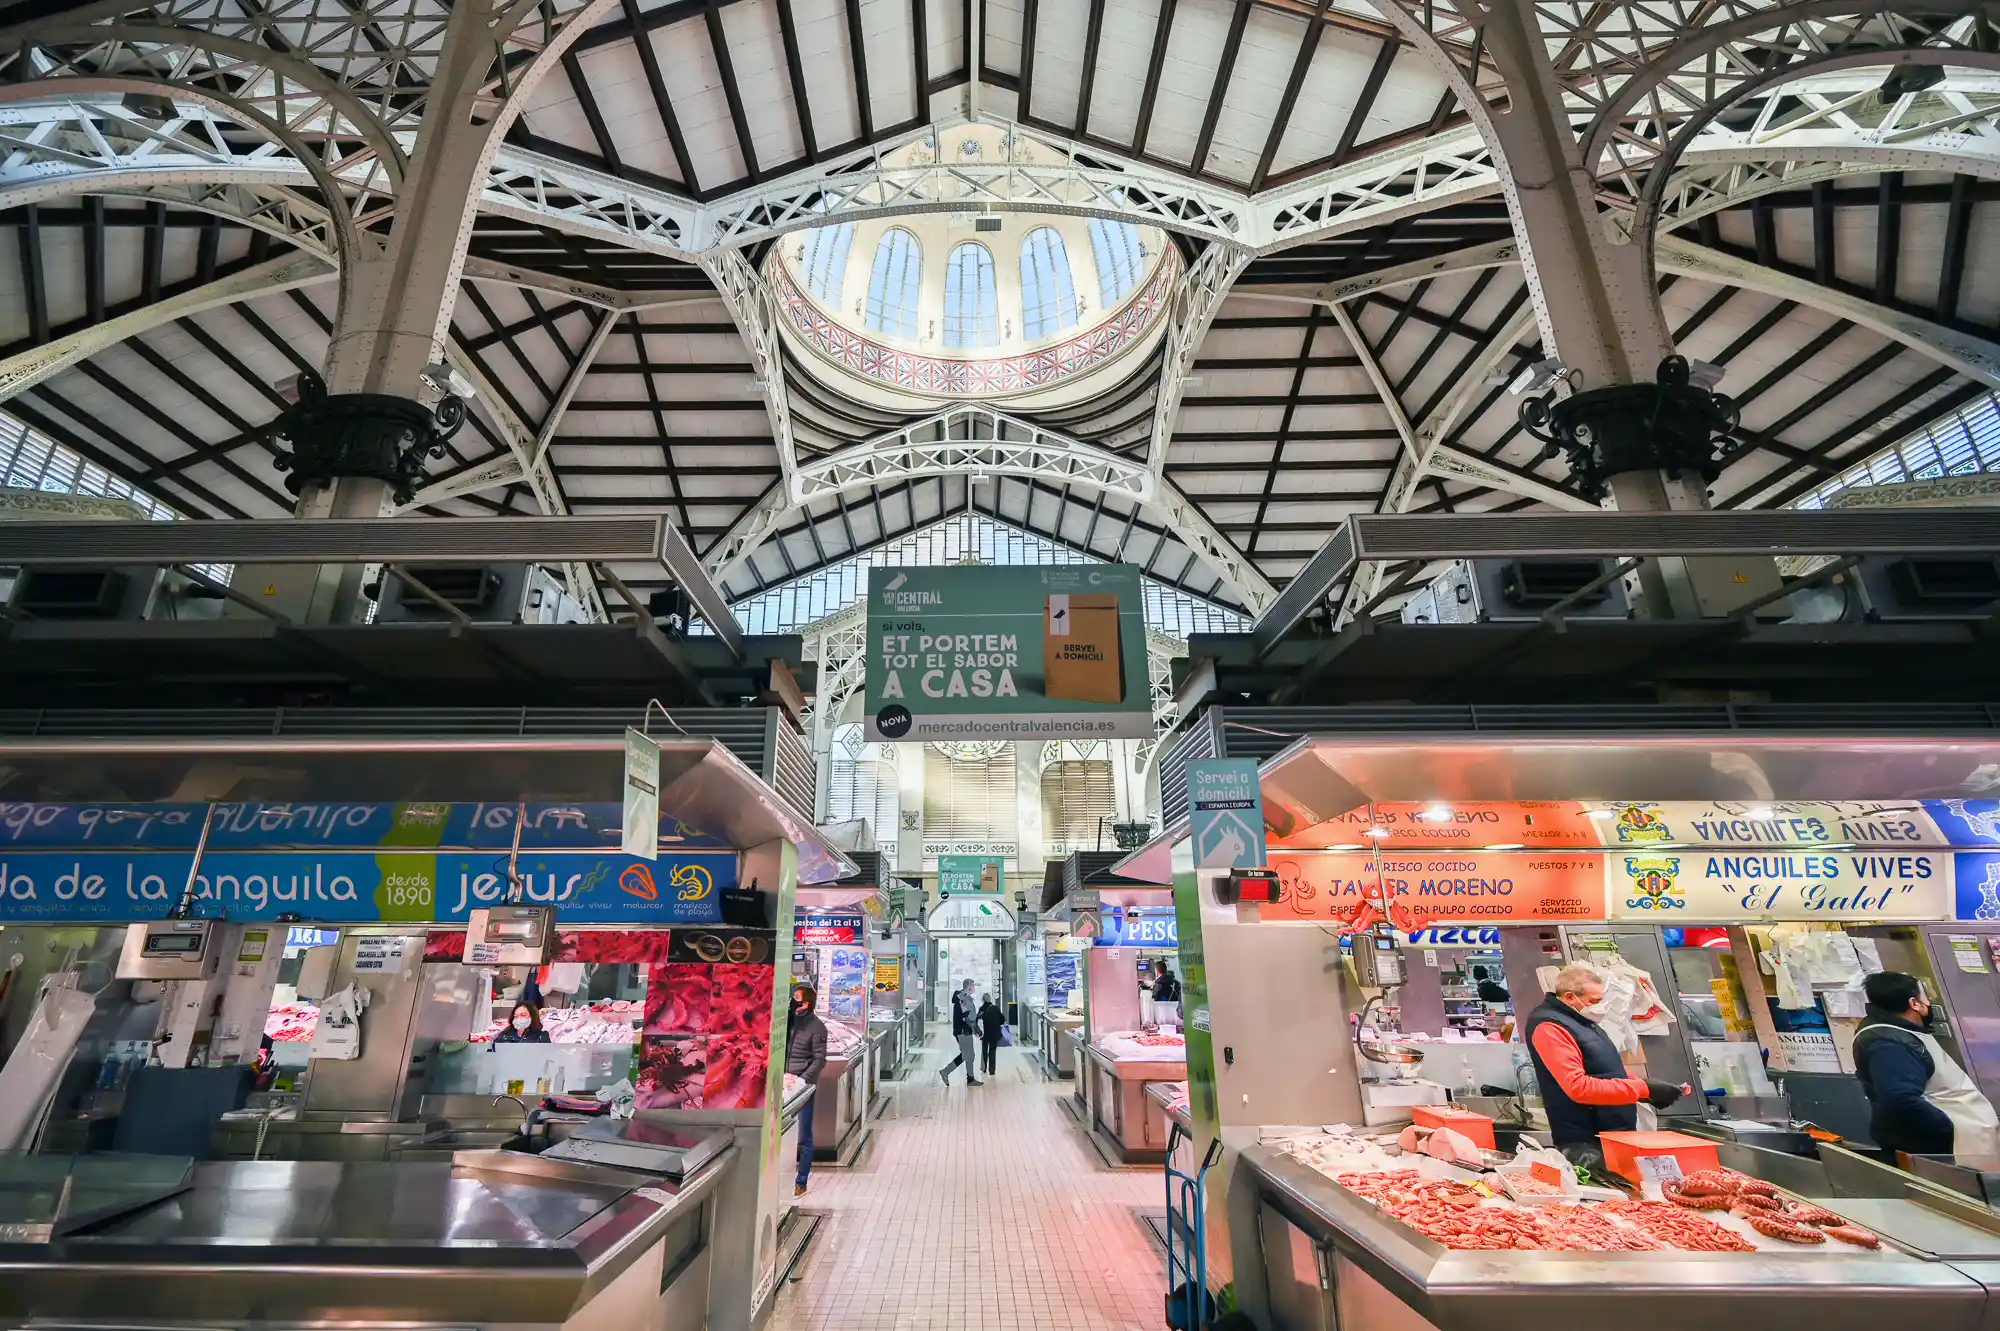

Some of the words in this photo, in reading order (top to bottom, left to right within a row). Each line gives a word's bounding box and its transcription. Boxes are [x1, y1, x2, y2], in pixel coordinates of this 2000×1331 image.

[897, 589, 943, 604] CENTRAL
[882, 621, 893, 631] si
[896, 621, 925, 632] vols,
[883, 635, 910, 652] ET
[920, 634, 1017, 652] PORTEM
[1063, 644, 1095, 652] SERVEI
[883, 654, 919, 669] TOT
[926, 653, 946, 668] EL
[954, 653, 1017, 668] SABOR
[1055, 652, 1061, 660] A
[1064, 652, 1103, 661] DOMICILI
[882, 670, 905, 699] A
[921, 668, 1018, 698] CASA
[880, 714, 908, 729] NOVA
[918, 719, 1115, 734] mercadocentralvalencia.es
[1196, 770, 1237, 784] Servei
[1240, 773, 1249, 784] a
[1197, 786, 1250, 800] domicili
[1365, 862, 1422, 872] MRISCO
[1428, 861, 1477, 872] COCIDO
[1529, 862, 1568, 870] PUESTOS
[1705, 856, 1839, 879] ANGUILES
[1851, 856, 1932, 879] VIVES
[54, 863, 107, 901] de
[126, 863, 169, 901] la
[194, 862, 358, 911] anguila
[386, 872, 429, 888] desde
[950, 883, 974, 891] CASA
[1419, 878, 1513, 896] MORENO
[386, 888, 431, 906] 1890
[687, 908, 713, 917] playa
[1413, 905, 1429, 914] EN
[1433, 905, 1466, 914] PULPO
[1470, 905, 1513, 914] COCIDO
[819, 919, 832, 927] del
[833, 919, 842, 927] 12
[843, 919, 852, 927] al
[853, 919, 861, 927] 15
